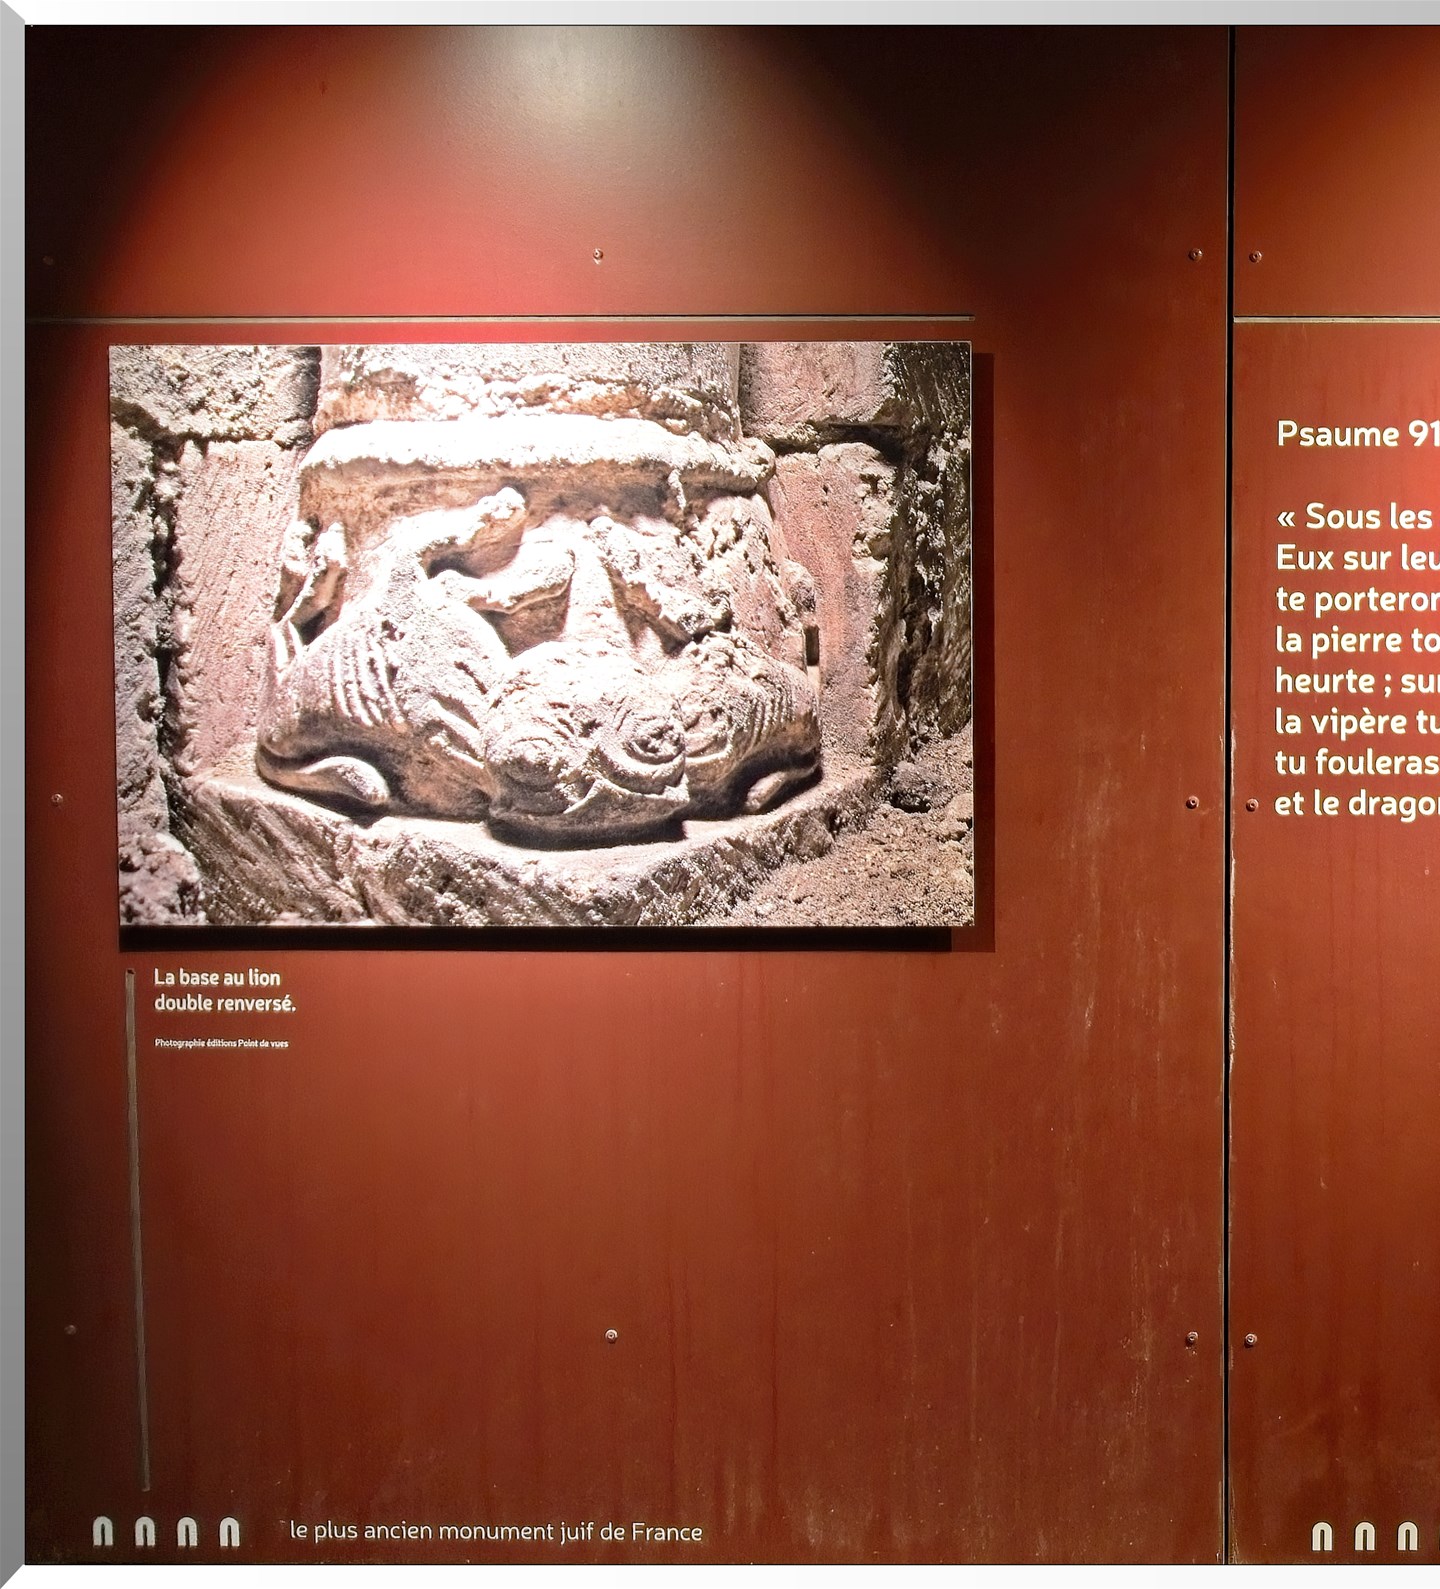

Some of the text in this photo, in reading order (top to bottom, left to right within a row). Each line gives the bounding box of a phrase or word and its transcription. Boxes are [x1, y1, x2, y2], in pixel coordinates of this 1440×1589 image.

[1278, 420, 1400, 447] Psaume
[1408, 419, 1440, 447] 91
[1306, 502, 1381, 530] Sous
[1390, 502, 1433, 530] les
[1277, 543, 1334, 571] Eux
[1343, 550, 1392, 571] sur
[1276, 586, 1306, 612] te
[1276, 625, 1302, 653] la
[1312, 625, 1403, 660] pierre
[1276, 666, 1376, 694] heurte
[1275, 706, 1302, 734] la
[1310, 706, 1407, 742] vipère
[1274, 750, 1306, 775] tu
[1315, 747, 1440, 775] fouleras
[1274, 791, 1305, 816] et
[1314, 788, 1340, 816] le
[154, 967, 281, 987] La base au lion
[154, 993, 297, 1012] double renversé.
[290, 1519, 703, 1546] le plus ancien monument juif de France
